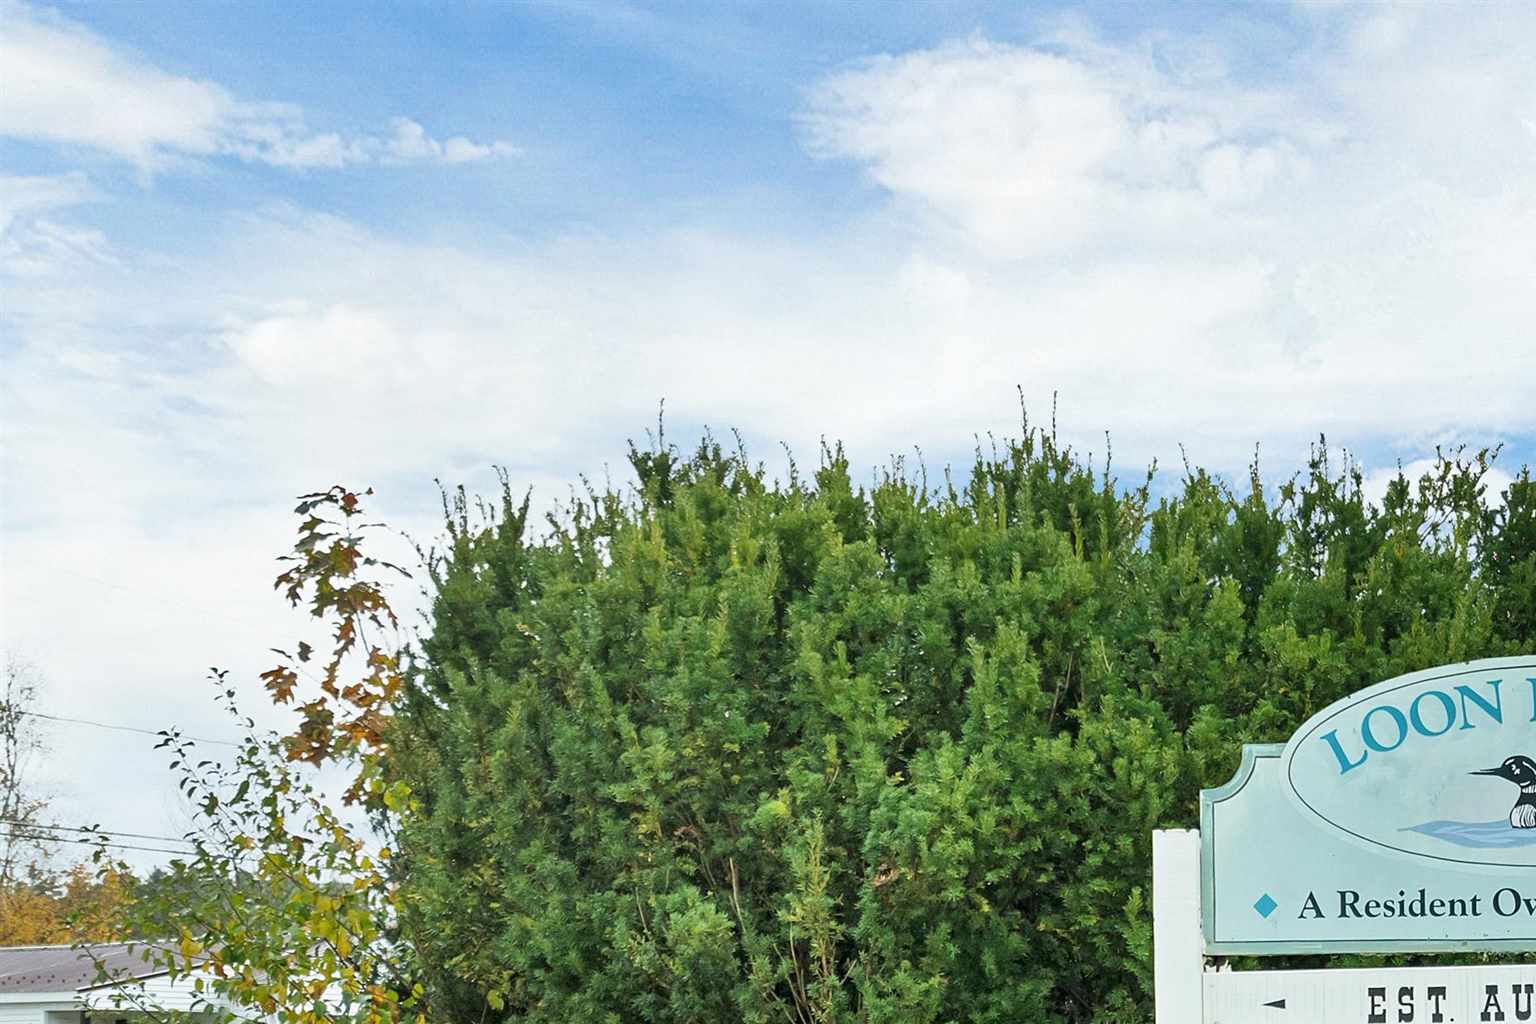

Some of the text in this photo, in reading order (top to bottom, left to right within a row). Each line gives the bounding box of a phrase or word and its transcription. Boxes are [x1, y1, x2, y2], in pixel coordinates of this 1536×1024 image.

[1319, 679, 1505, 776] LOON
[1298, 891, 1325, 919] A
[1337, 888, 1482, 918] Resident
[1368, 987, 1454, 1023] EST.
